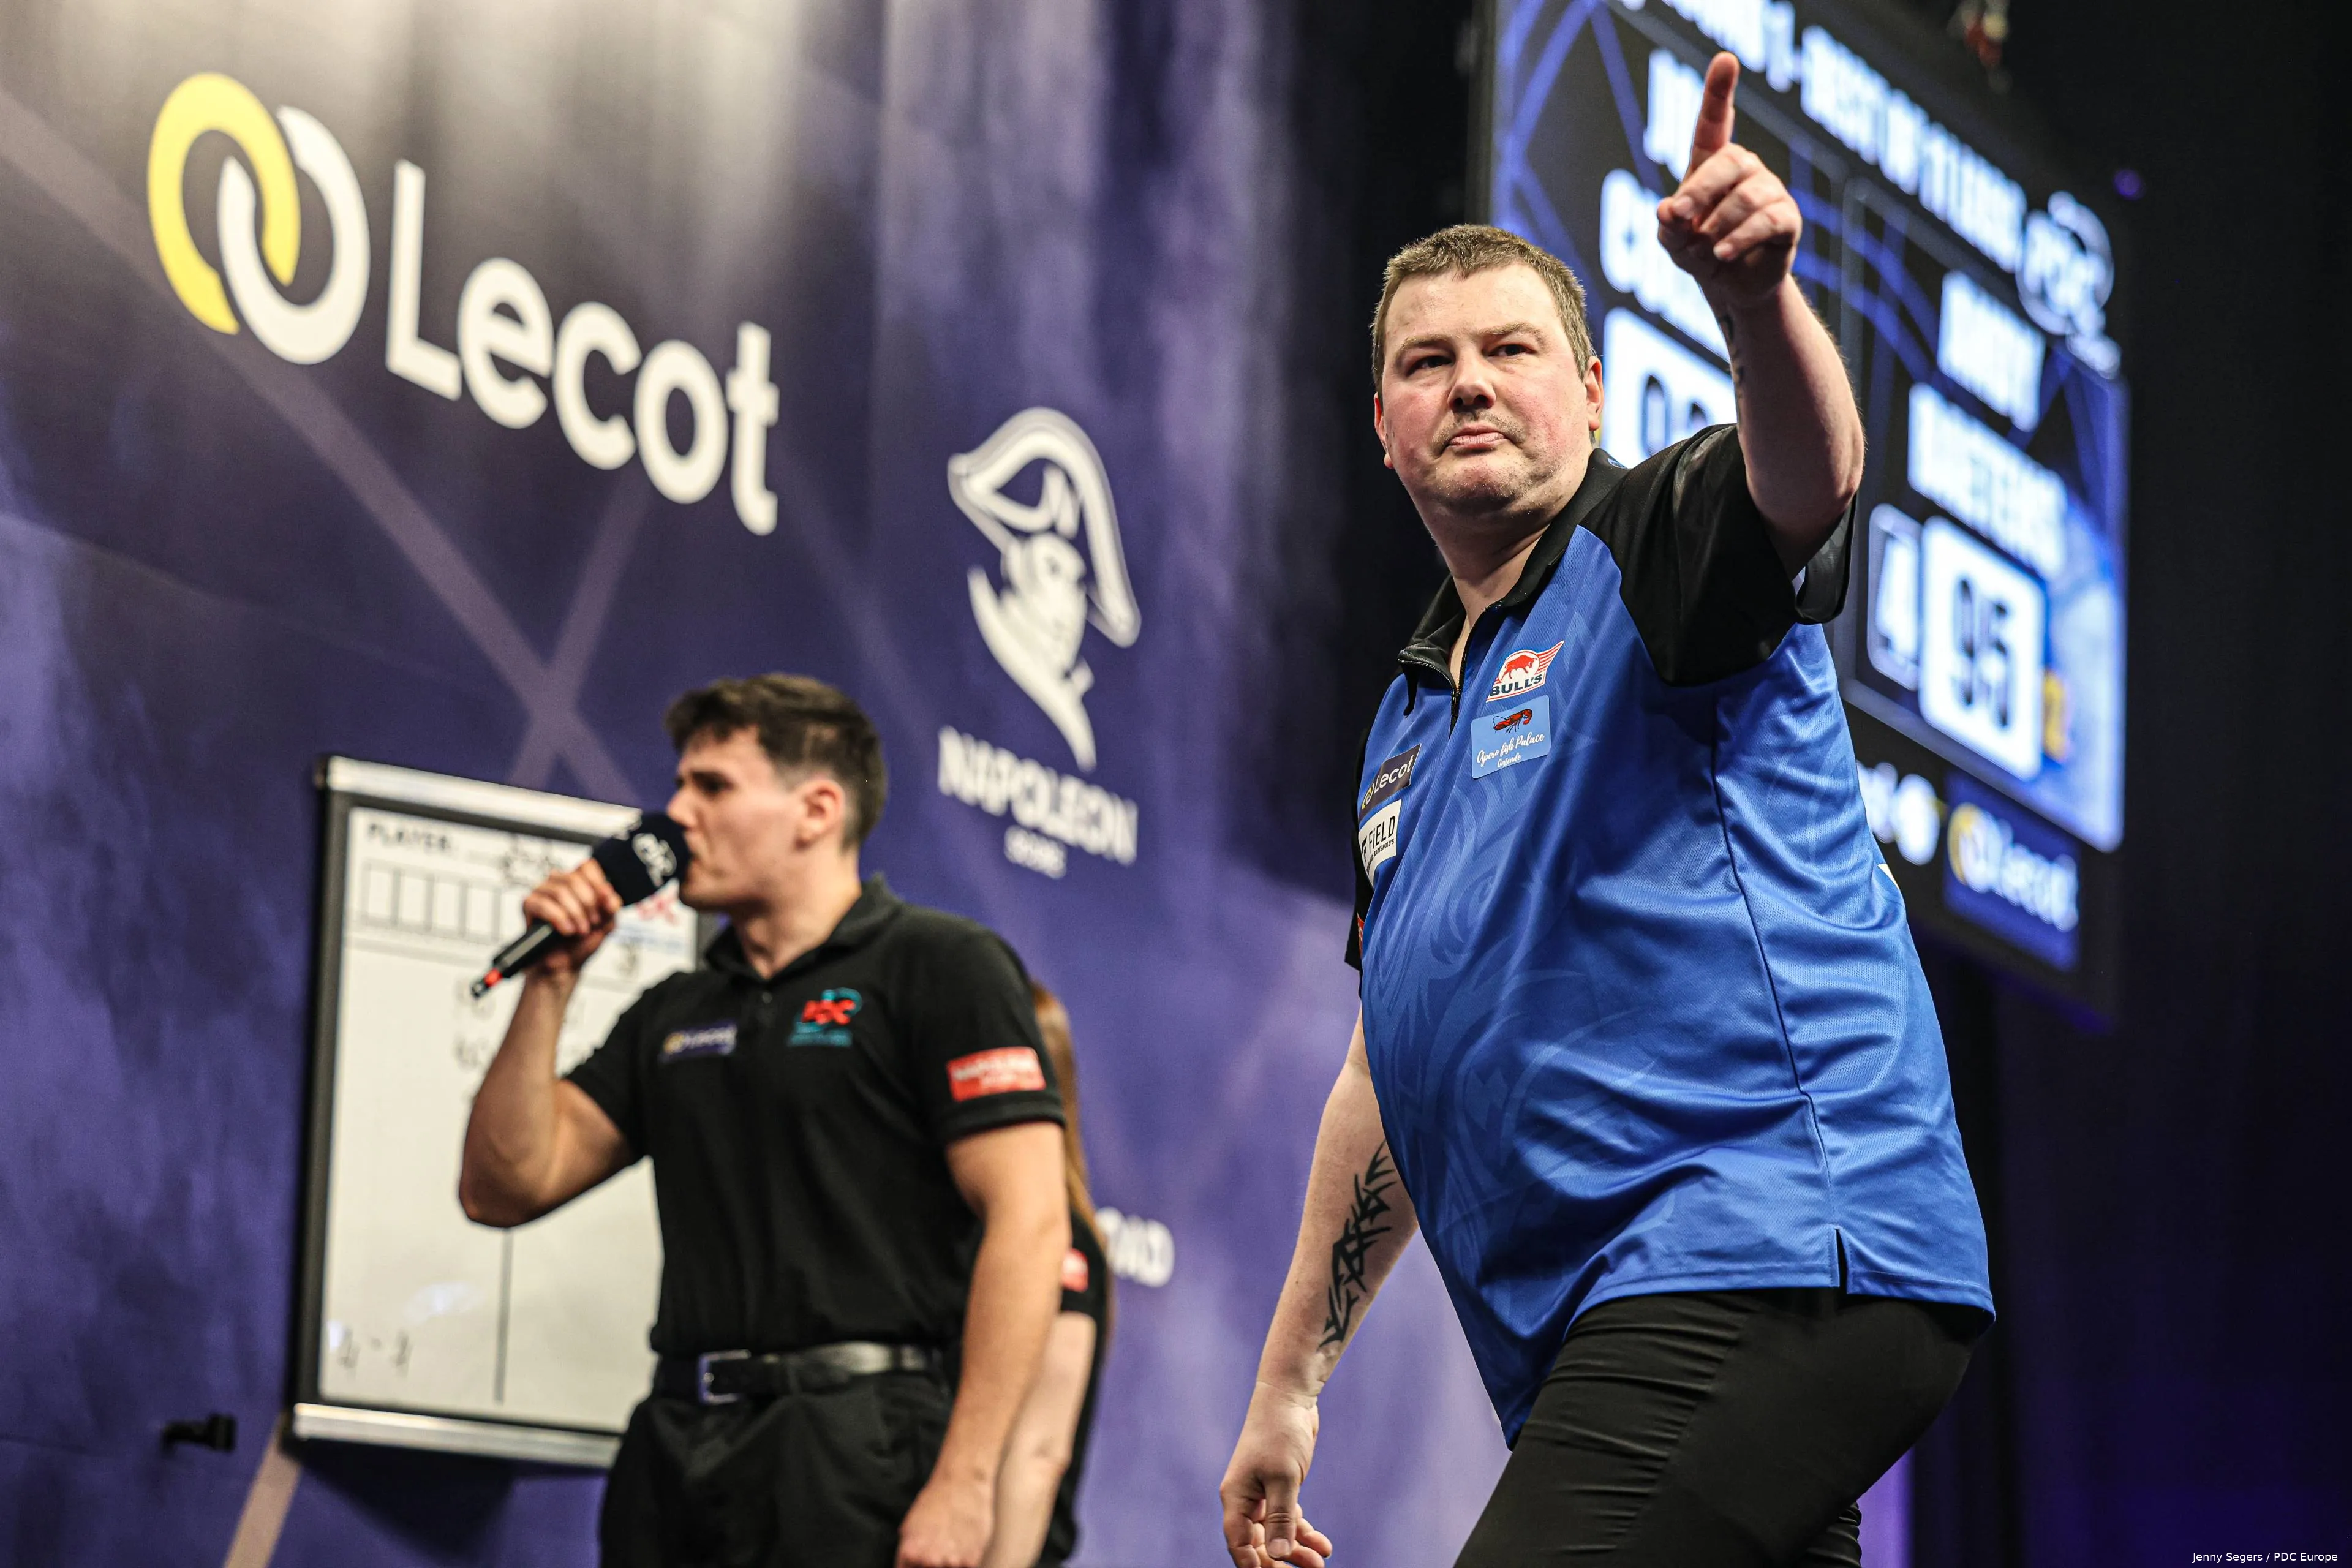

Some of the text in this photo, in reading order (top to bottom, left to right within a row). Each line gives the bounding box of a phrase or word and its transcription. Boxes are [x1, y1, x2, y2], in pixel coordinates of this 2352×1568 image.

[385, 159, 779, 537] Lecot
[1875, 539, 1920, 660] 4
[1490, 674, 1543, 697] BULL'S
[1952, 578, 2013, 731] 95
[1373, 754, 1414, 794] Lecot
[1515, 731, 1545, 749] Palace
[938, 725, 1138, 865] NAPOLEON
[368, 821, 451, 852] PLAYER
